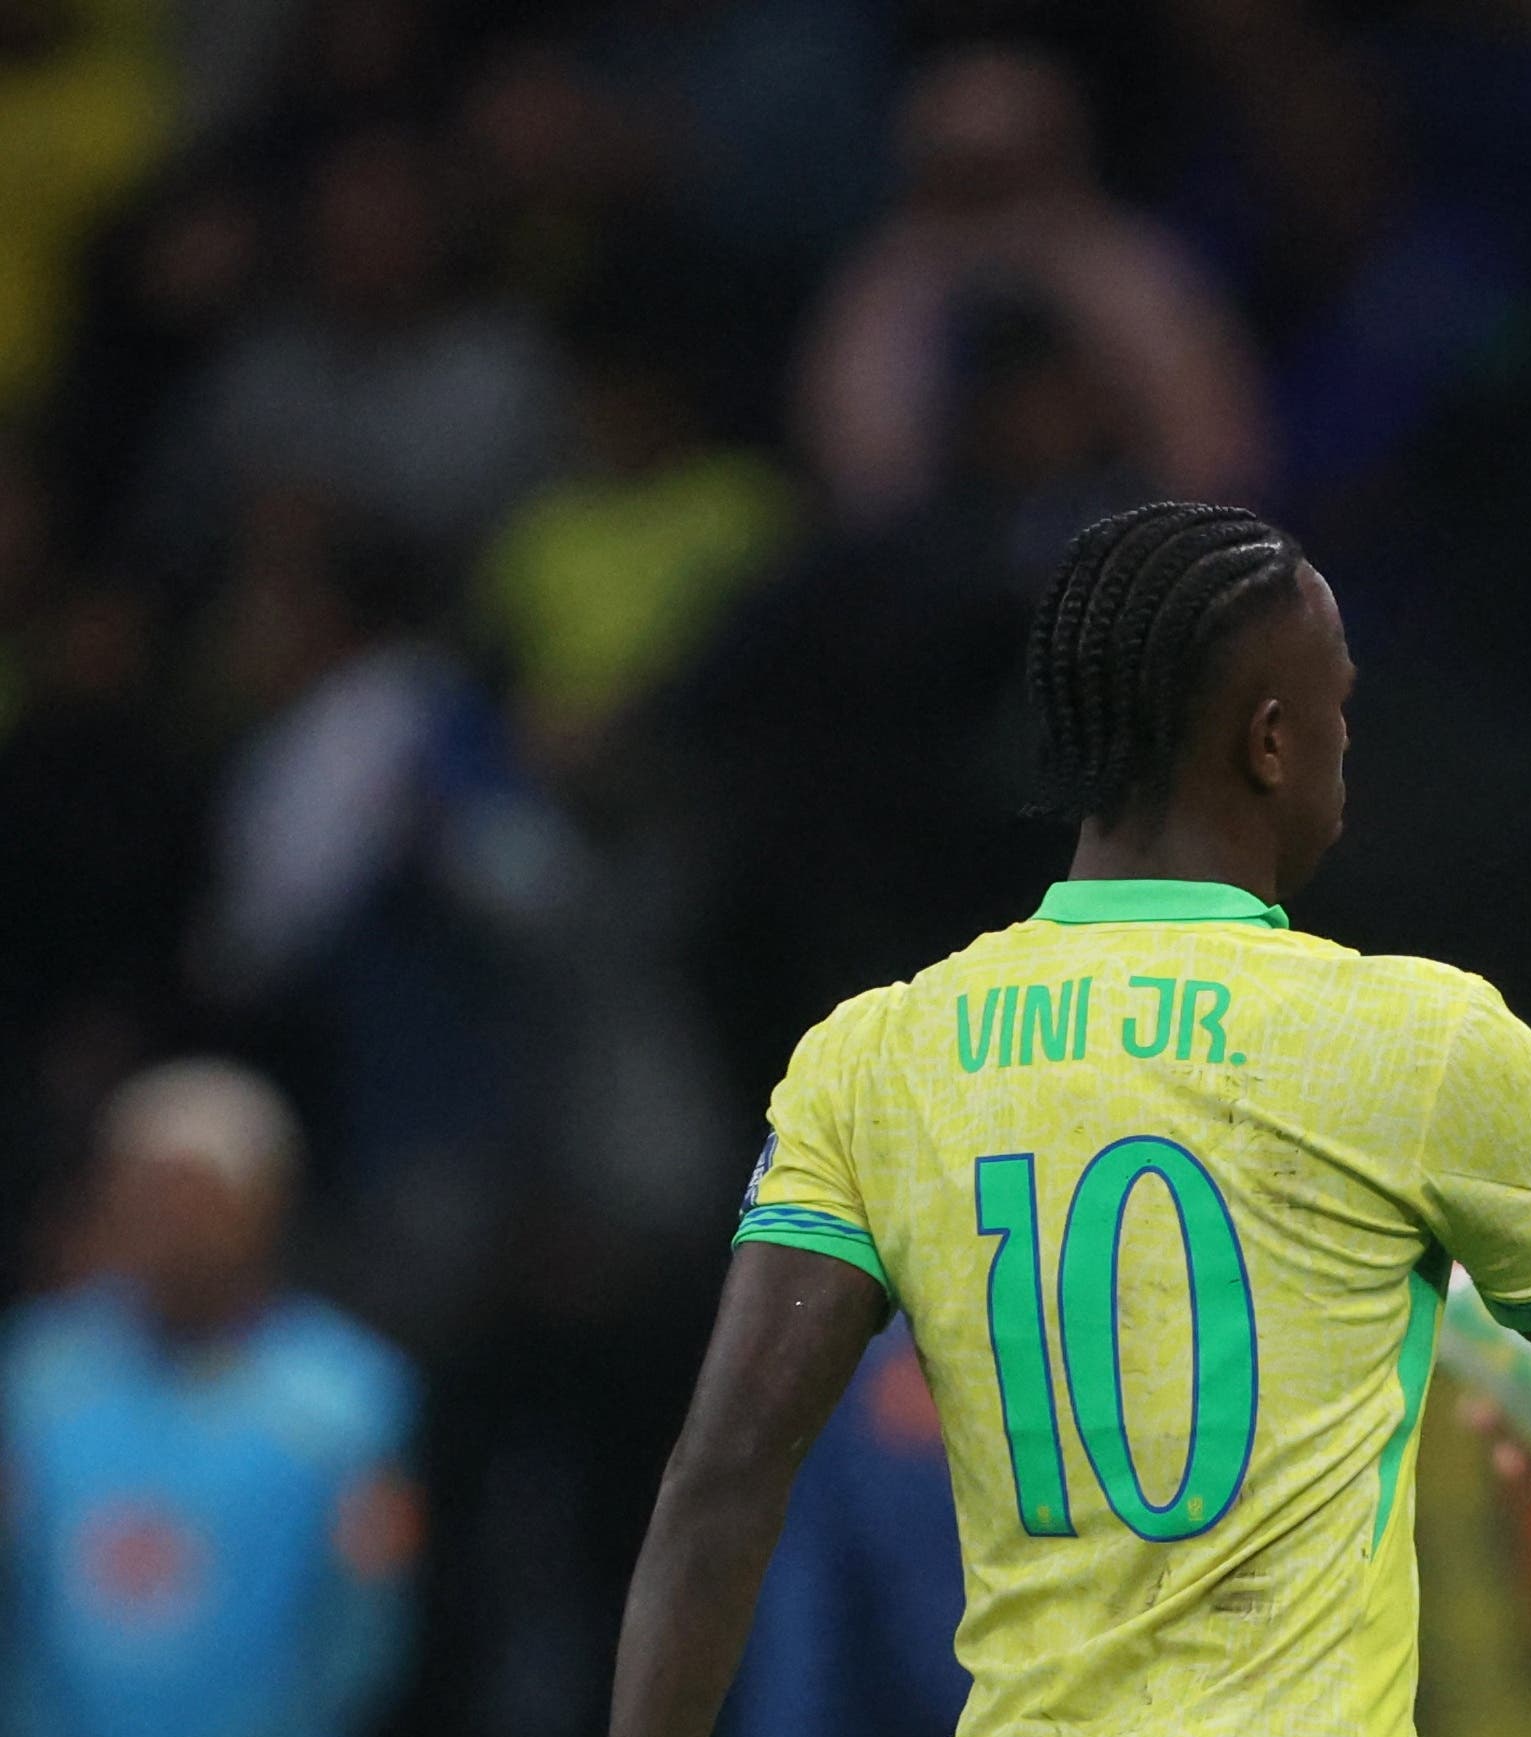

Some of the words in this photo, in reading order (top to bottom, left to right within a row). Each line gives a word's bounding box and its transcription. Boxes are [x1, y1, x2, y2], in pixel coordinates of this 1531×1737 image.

[956, 976, 1093, 1073] VINI
[1121, 976, 1248, 1066] JR.
[974, 1134, 1260, 1544] 10
